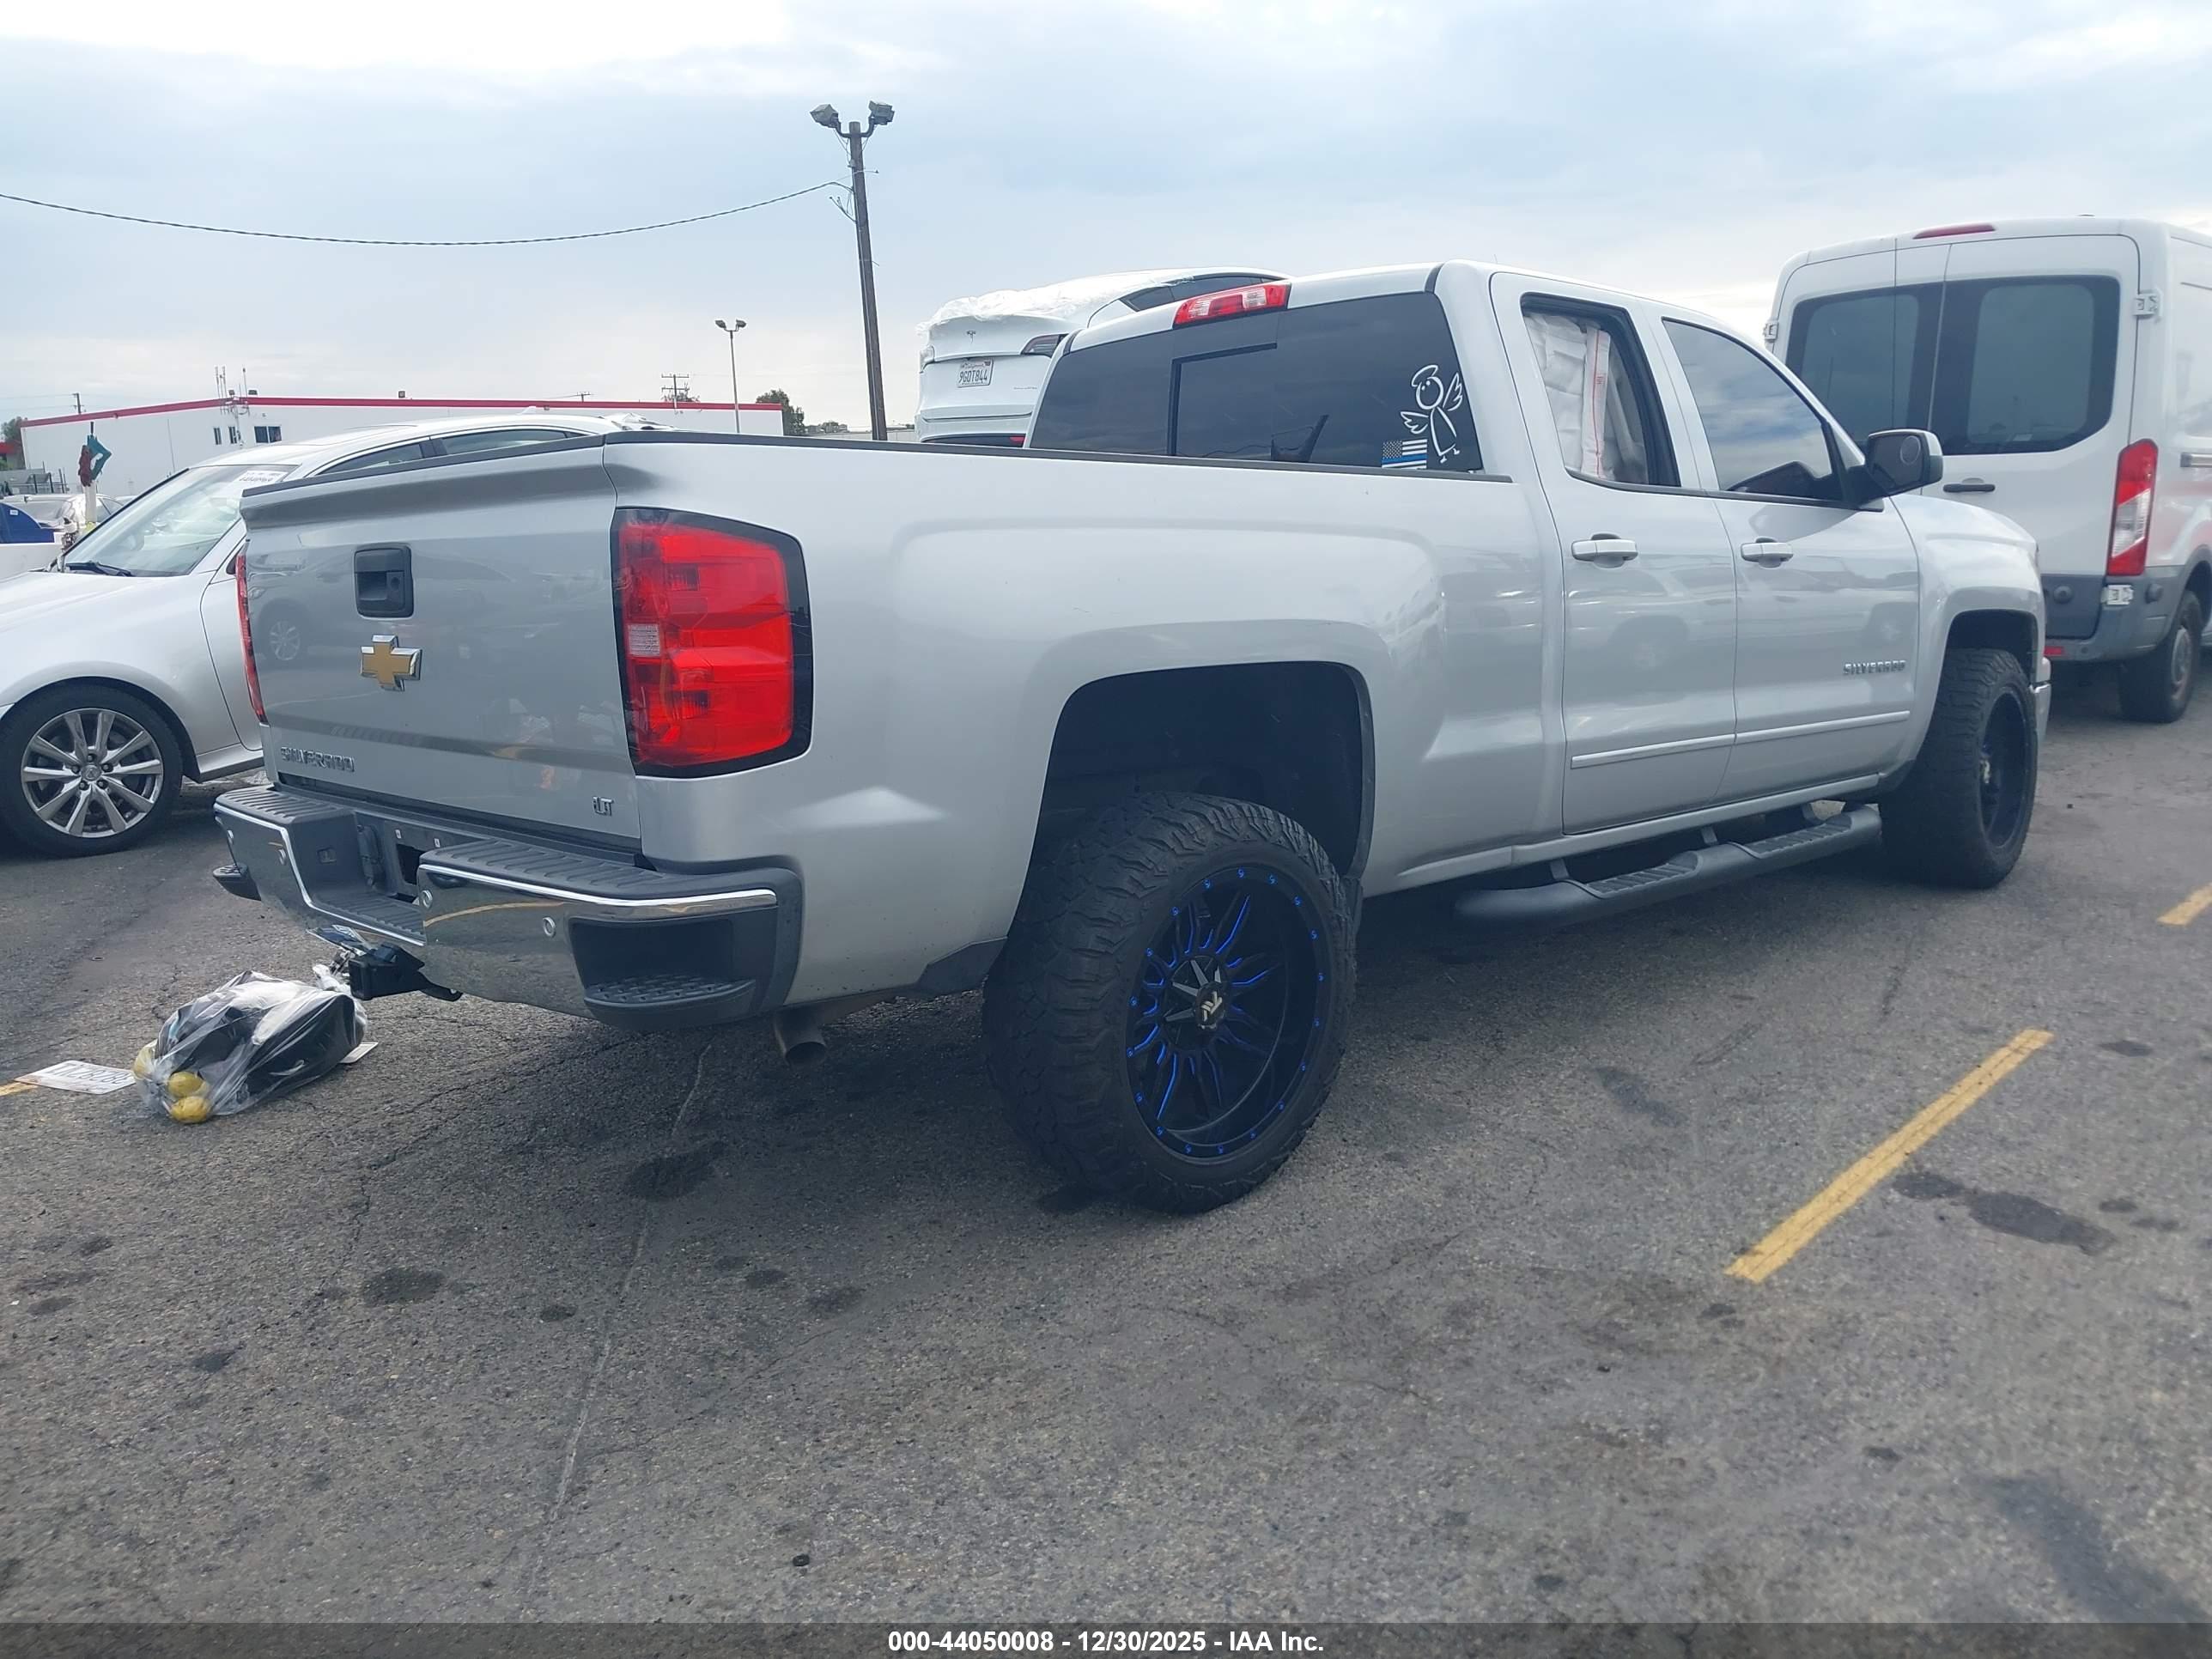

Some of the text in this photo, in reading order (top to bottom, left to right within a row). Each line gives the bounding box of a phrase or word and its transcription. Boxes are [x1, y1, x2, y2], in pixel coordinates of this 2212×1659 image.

[1843, 659, 1906, 675] SILVERADO
[280, 745, 356, 772] SILVERADO
[592, 796, 614, 816] LT
